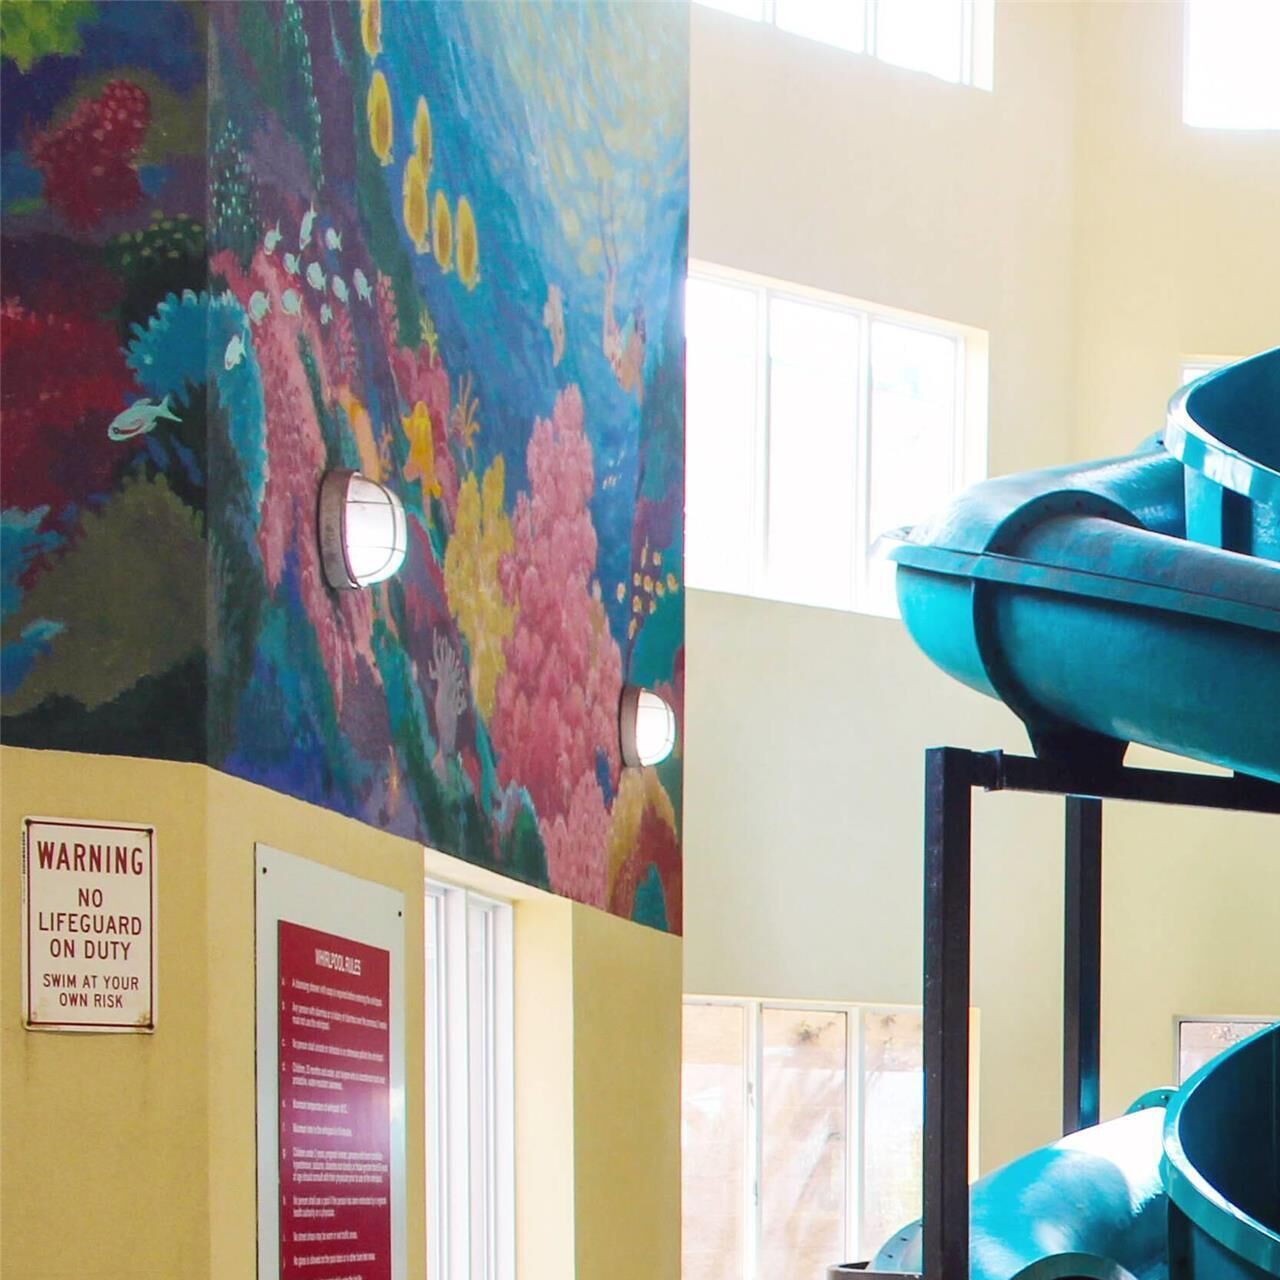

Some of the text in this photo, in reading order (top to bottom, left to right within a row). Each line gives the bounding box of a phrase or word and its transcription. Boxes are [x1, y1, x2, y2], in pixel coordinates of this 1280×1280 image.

[37, 841, 143, 876] WARNING
[78, 888, 103, 908] NO
[39, 911, 142, 935] LIFEGUARD
[50, 938, 132, 961] ON DUTY
[43, 973, 139, 991] SWIM AT YOUR
[59, 993, 123, 1009] OWN RISK
